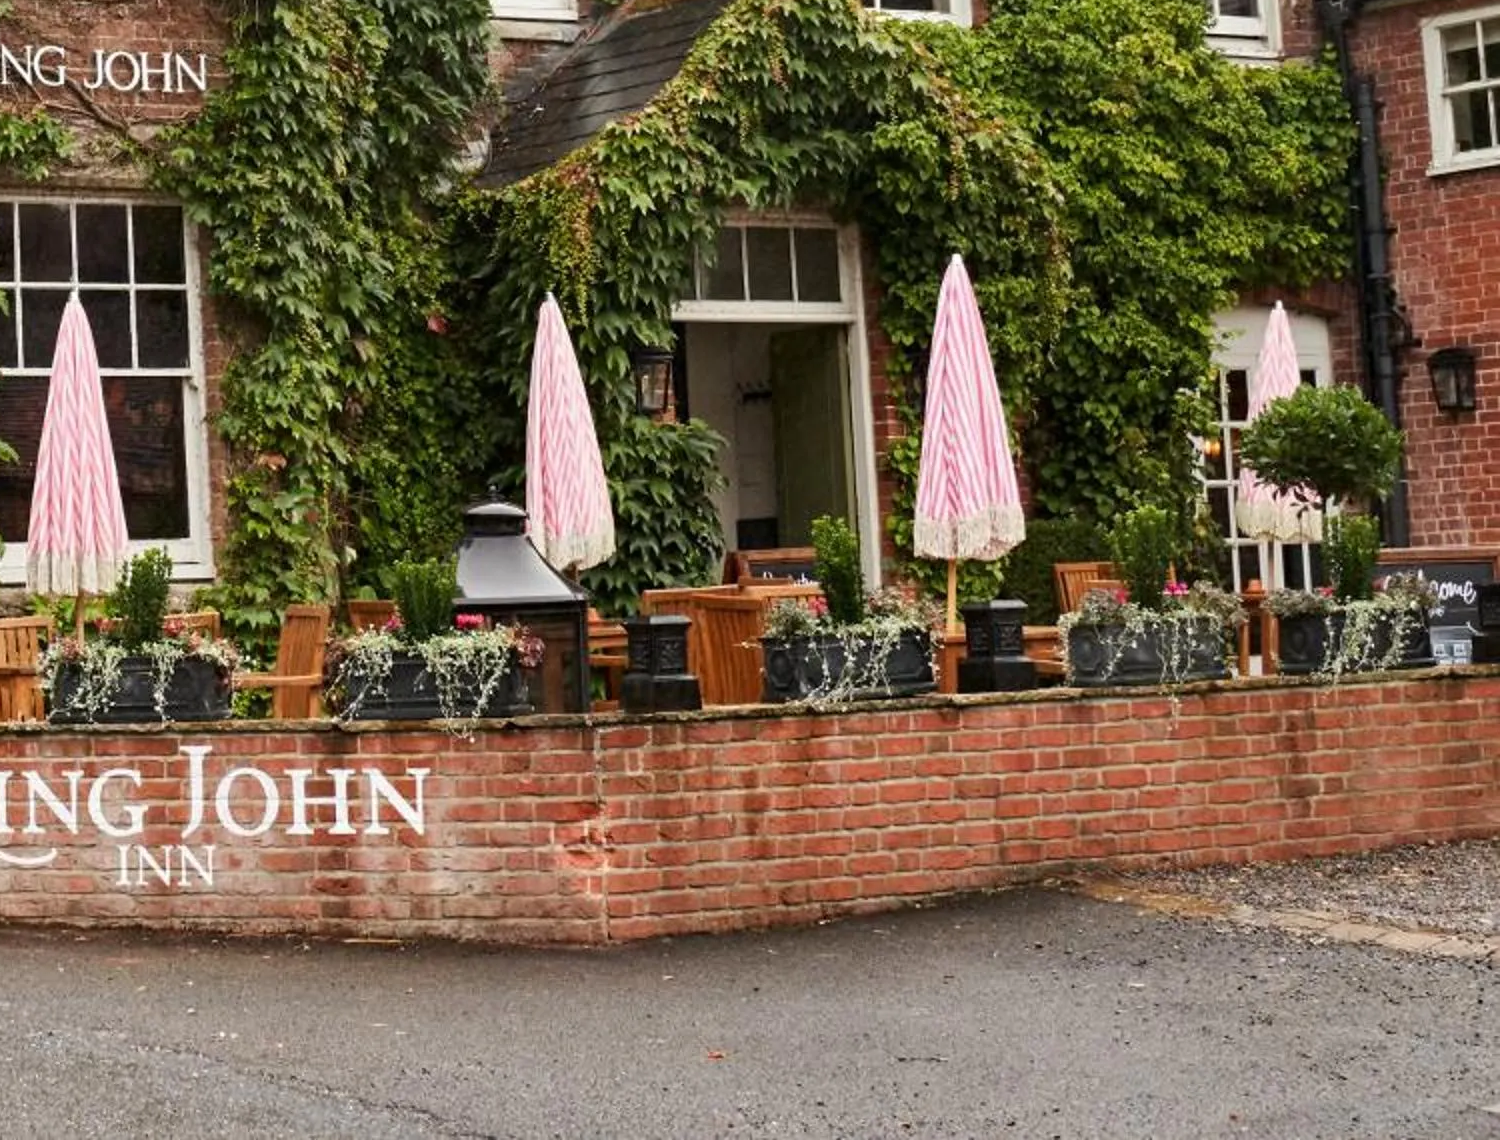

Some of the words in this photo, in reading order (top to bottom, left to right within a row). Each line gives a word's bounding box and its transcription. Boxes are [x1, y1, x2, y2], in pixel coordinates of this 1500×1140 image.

[83, 49, 206, 93] JOHN
[179, 745, 430, 838] JOHN
[115, 844, 216, 887] INN
